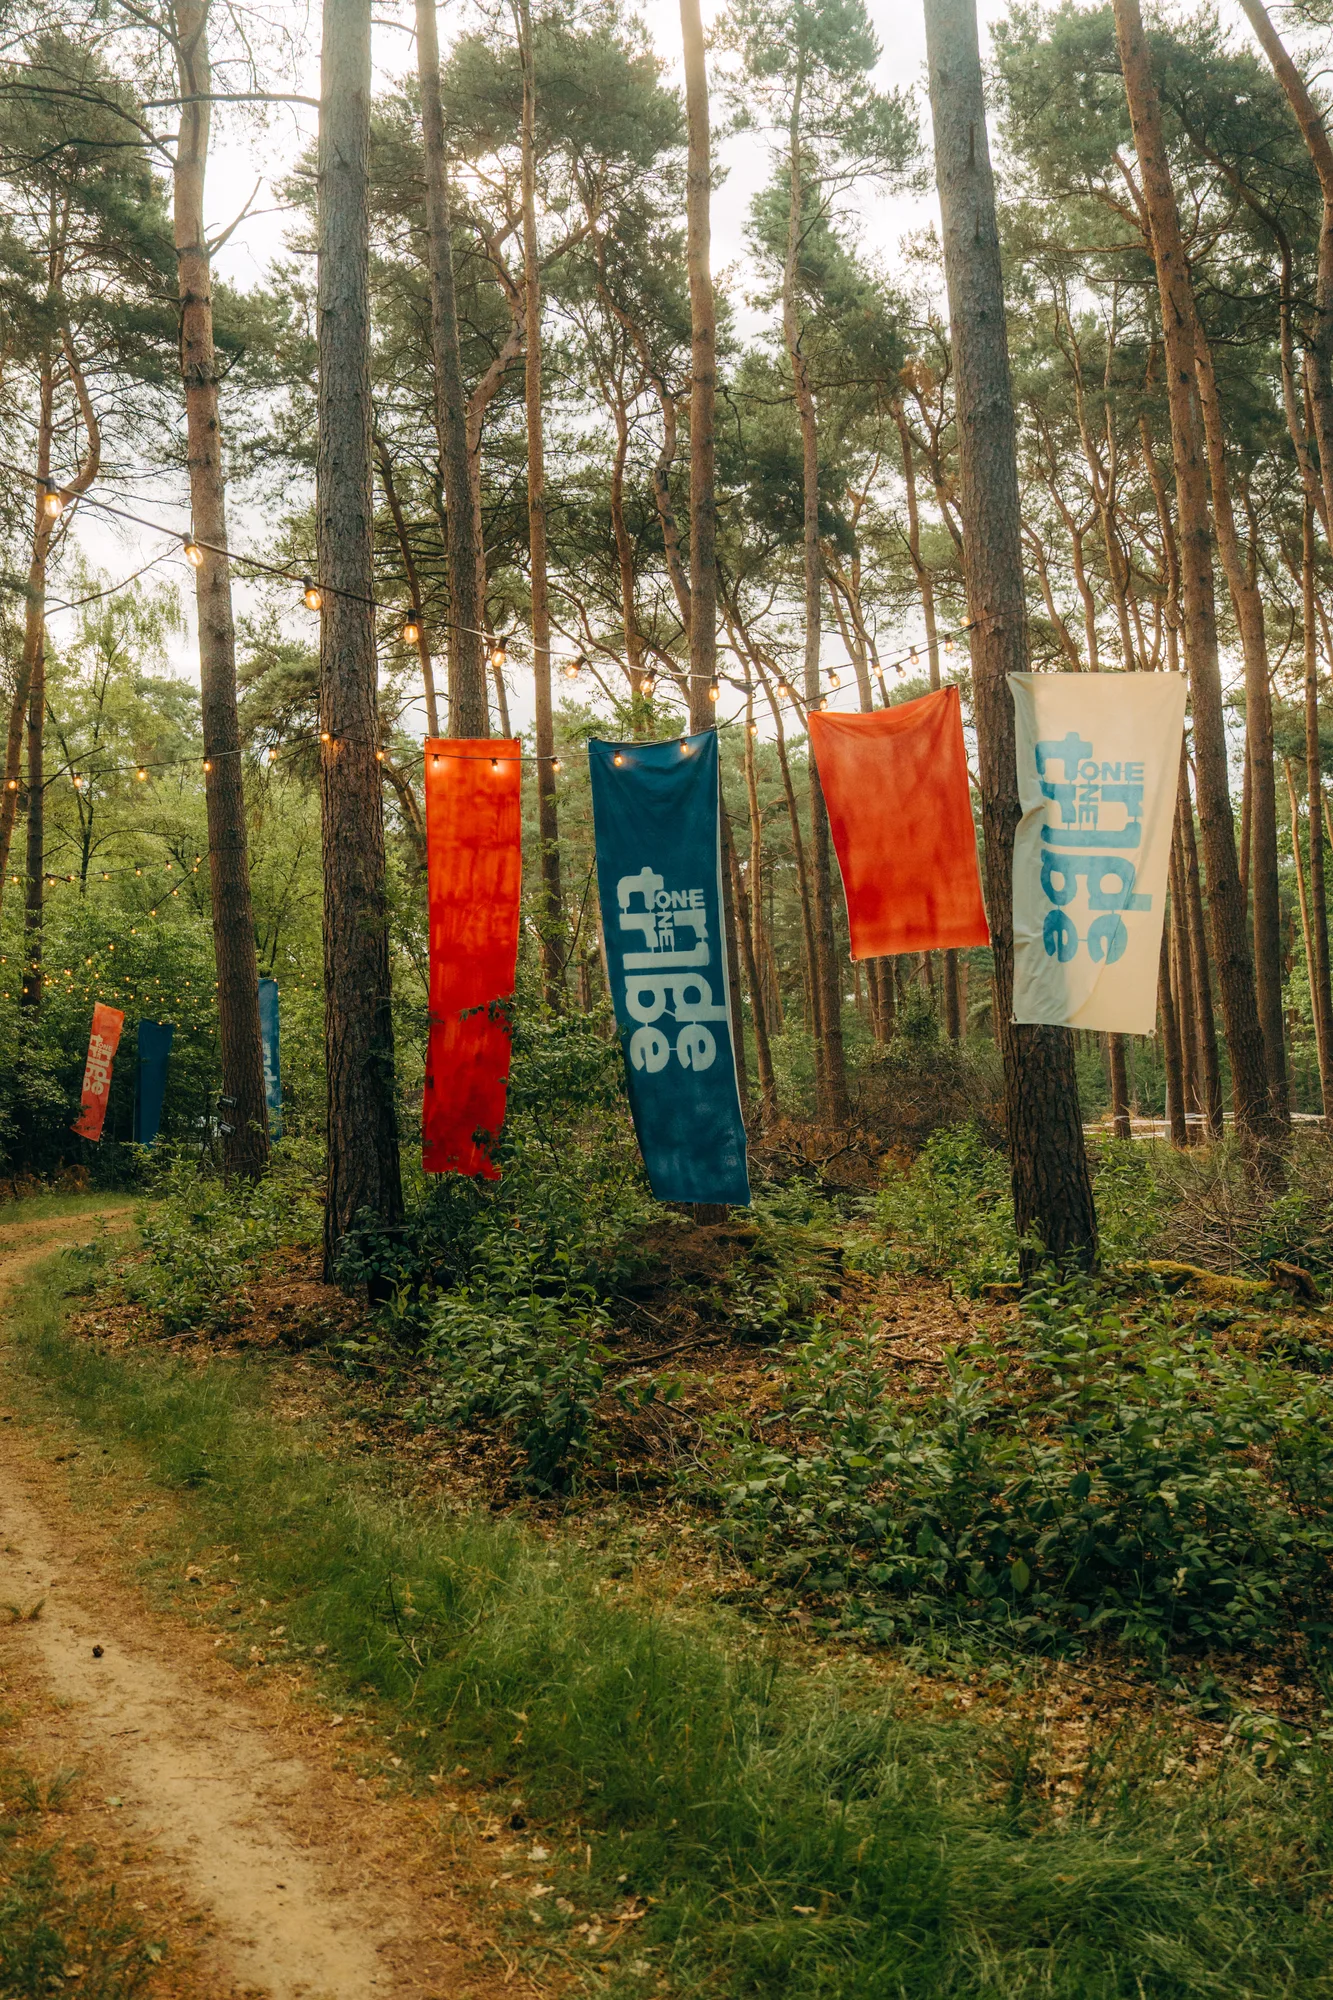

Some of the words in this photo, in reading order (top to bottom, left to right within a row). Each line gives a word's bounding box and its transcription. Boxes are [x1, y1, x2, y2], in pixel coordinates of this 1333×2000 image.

[1035, 731, 1093, 963] tribe
[1079, 761, 1145, 782] ONE
[655, 888, 705, 909] ONE
[1088, 784, 1152, 965] ride
[617, 866, 670, 1073] tribe
[673, 908, 727, 1072] ride
